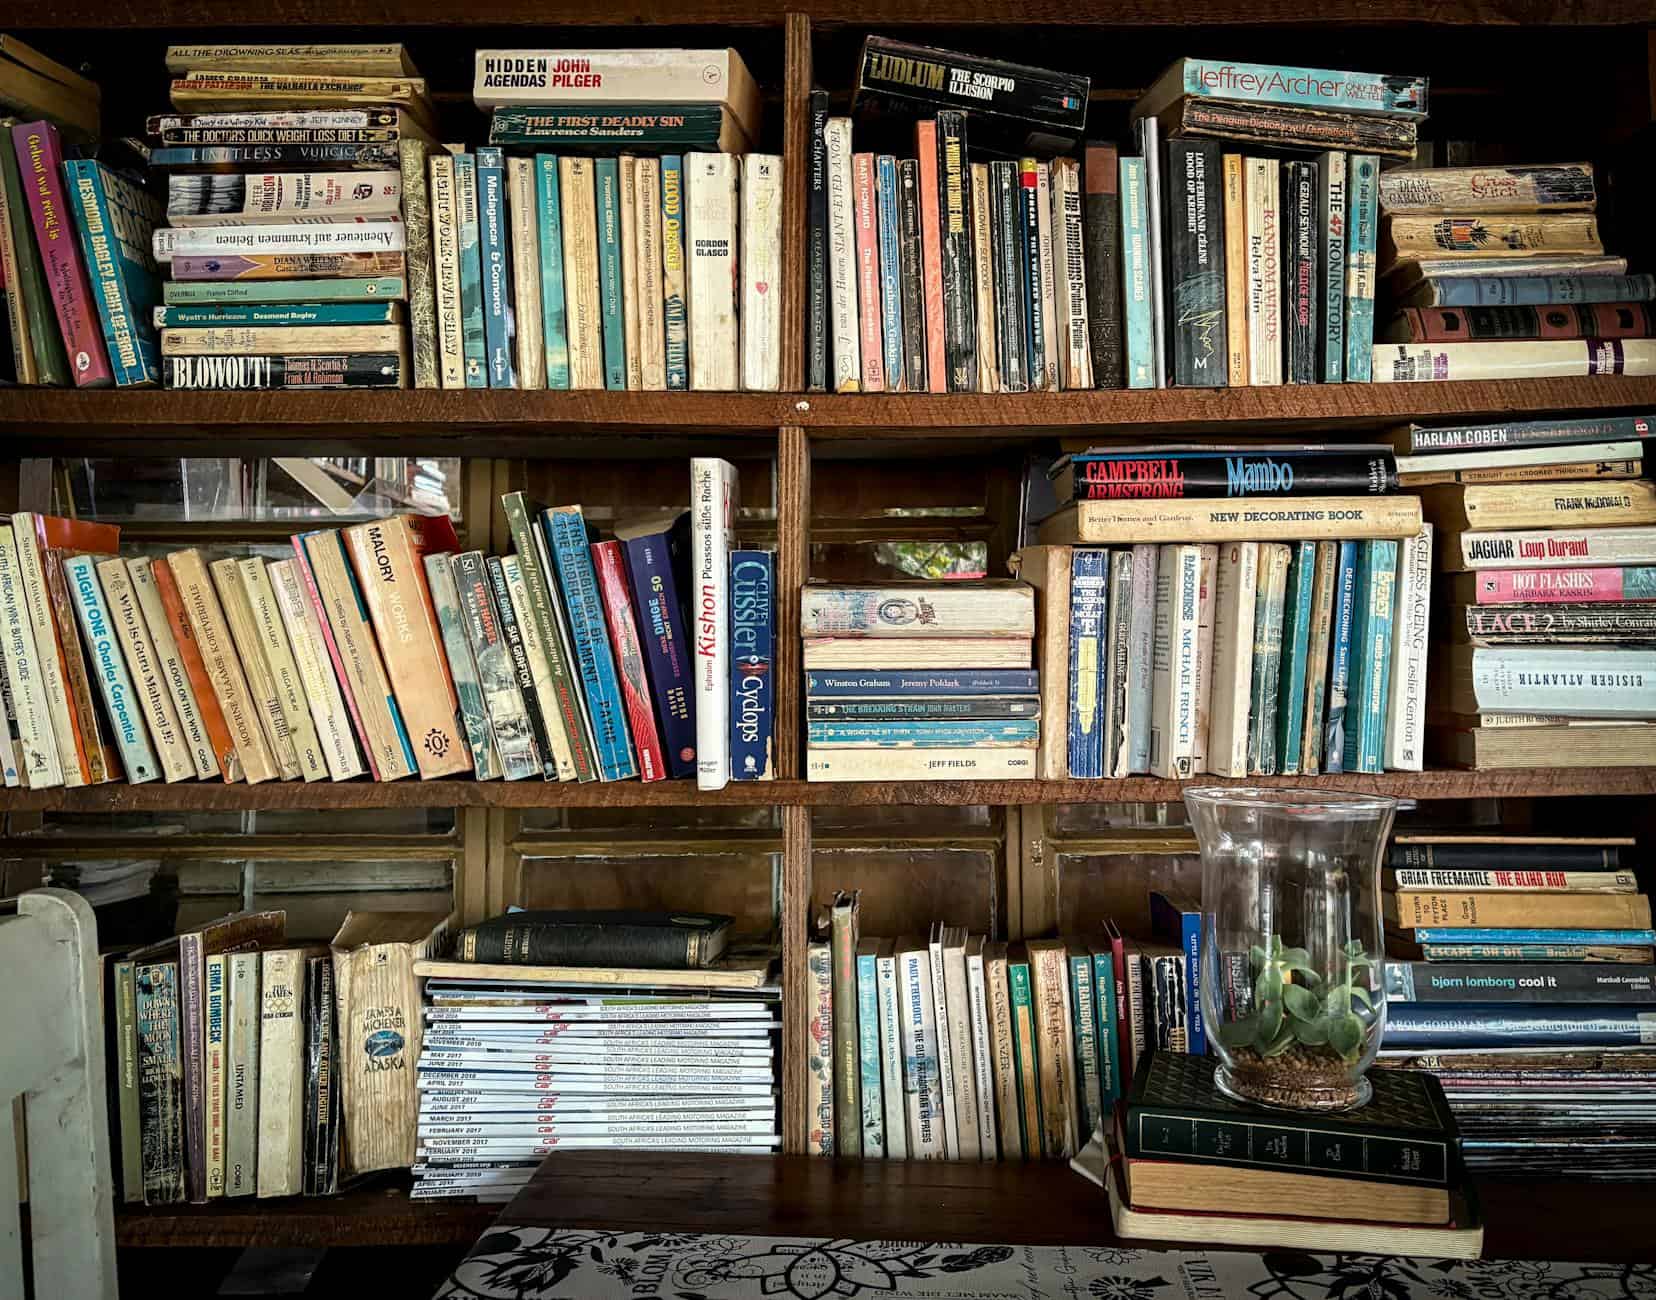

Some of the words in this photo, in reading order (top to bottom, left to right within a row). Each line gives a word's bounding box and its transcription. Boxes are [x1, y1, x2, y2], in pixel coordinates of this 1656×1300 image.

[214, 48, 274, 56] DROWNING
[485, 60, 546, 72] HIDDEN
[553, 59, 590, 73] JOHN
[484, 74, 546, 87] AGENDAS
[552, 74, 601, 88] PILGER
[869, 53, 946, 91] LUDLUM
[951, 69, 971, 83] THE
[973, 72, 1015, 92] SCORPIO
[949, 84, 993, 100] ILLUSION
[184, 130, 200, 142] THE
[203, 130, 246, 142] DOCTOR'S
[248, 130, 274, 142] QUICK
[277, 130, 311, 141] WEIGHT
[313, 130, 336, 141] LOSS
[338, 129, 355, 141] DIET
[525, 117, 554, 126] THE
[557, 117, 595, 126] FIRST
[598, 117, 656, 126] DEADLY
[660, 116, 683, 126] SIN
[525, 128, 585, 137] Lawrence
[589, 127, 643, 137] Sanders
[1185, 152, 1194, 173] DOOD
[1186, 174, 1195, 186] OP
[1194, 152, 1205, 231] LOUIS-FERDINAND
[75, 176, 104, 234] DESMOND
[484, 175, 499, 245] Madagascar
[1186, 188, 1196, 233] KREDIET
[1329, 180, 1342, 212] THE
[216, 234, 254, 245] Beinen
[258, 233, 308, 246] krummen
[310, 233, 331, 245] auf
[335, 231, 393, 245] Abenteuer
[1329, 214, 1342, 236] 47
[90, 233, 115, 279] BAGLEY
[490, 251, 500, 260] &
[696, 240, 728, 248] GORDON
[1197, 233, 1207, 264] CÉLINE
[1250, 235, 1261, 274] Belva
[1263, 209, 1275, 282] RANDOM
[1328, 239, 1341, 292] RONIN
[490, 263, 502, 315] Comoros
[1251, 278, 1262, 312] Plain
[109, 313, 128, 331] OF
[1264, 284, 1276, 341] WINDS
[1327, 294, 1341, 345] STORY
[113, 327, 138, 369] ERROR
[173, 356, 271, 388] BLOWOUT!
[1415, 432, 1462, 447] HARLAN
[1467, 429, 1507, 444] COBEN
[700, 470, 711, 502] Rache
[1086, 459, 1183, 483] CAMPBELL
[1226, 457, 1294, 496] Mambo
[1088, 481, 1184, 499] ARMSTRONG
[700, 505, 712, 530] süße
[1210, 512, 1240, 522] NEW
[1244, 511, 1324, 522] DECORATING
[1328, 510, 1363, 521] BOOK
[366, 525, 396, 585] MALORY
[701, 533, 712, 579] Picassos
[1414, 531, 1430, 591] AGELESS
[1468, 539, 1514, 560] JAGUAR
[1519, 539, 1545, 560] Loup
[1549, 537, 1588, 557] Durand
[72, 563, 97, 608] FLIGHT
[505, 562, 521, 583] TIM
[1343, 567, 1353, 590] DEAD
[1512, 573, 1537, 589] HOT
[1540, 572, 1593, 588] FLASHES
[116, 592, 137, 626] Who
[186, 582, 221, 653] KORTVERHALE
[386, 589, 414, 643] WORKS
[731, 561, 769, 651] Cussler
[756, 582, 768, 625] CLIVE
[1340, 592, 1351, 642] RECKONING
[86, 608, 106, 638] ONE
[128, 626, 141, 639] is
[507, 624, 519, 643] SUE
[697, 583, 716, 657] Kishon
[1411, 592, 1426, 649] AGEING
[1476, 613, 1538, 633] LACE
[1543, 614, 1554, 633] 2
[1562, 618, 1576, 628] by
[1577, 616, 1612, 629] Shirley
[96, 639, 120, 683] Charles
[131, 639, 151, 673] Guru
[511, 644, 531, 688] GRAFTON
[1180, 628, 1191, 688] MICHAEL
[166, 657, 183, 688] BLOOD
[212, 654, 236, 699] VLAAMSE
[703, 659, 714, 691] Ephraim
[825, 679, 857, 687] Winston
[859, 679, 890, 687] Graham
[901, 679, 928, 689] Jeremy
[930, 679, 960, 687] Poldark
[1405, 657, 1418, 693] Leslie
[1519, 674, 1584, 685] ATLANTIK
[1591, 675, 1642, 687] EISIGER
[141, 674, 169, 728] Maharaj
[176, 688, 188, 702] ON
[181, 702, 194, 719] THE
[734, 675, 764, 742] Cyclops
[106, 682, 138, 746] Carpentier
[228, 700, 253, 748] MODERNE
[1178, 691, 1190, 743] FRENCH
[1403, 696, 1417, 742] Kenton
[186, 718, 201, 743] WIND
[196, 748, 211, 772] CORGI
[928, 760, 947, 769] JEFF
[948, 760, 976, 768] FIELDS
[1400, 872, 1428, 885] BRIAN
[1431, 871, 1492, 886] FREEMANTLE
[1494, 871, 1512, 886] THE
[1515, 872, 1544, 886] BLIND
[1546, 872, 1567, 886] RUN
[209, 963, 221, 992] ERMA
[907, 958, 918, 981] PAUL
[1097, 976, 1105, 993] High
[1466, 976, 1515, 988] lomborg
[1519, 976, 1544, 987] cool
[1547, 976, 1557, 987] it
[208, 995, 221, 1043] BOMBECK
[909, 982, 922, 1025] THEROUX
[912, 1028, 923, 1043] THE
[914, 1044, 925, 1058] OLD
[1101, 1028, 1110, 1063] Desmond
[234, 1063, 244, 1109] UNTAMED
[915, 1061, 929, 1108] PATAGONIAN
[1102, 1065, 1111, 1090] Bagley
[919, 1109, 932, 1143] EXPRESS
